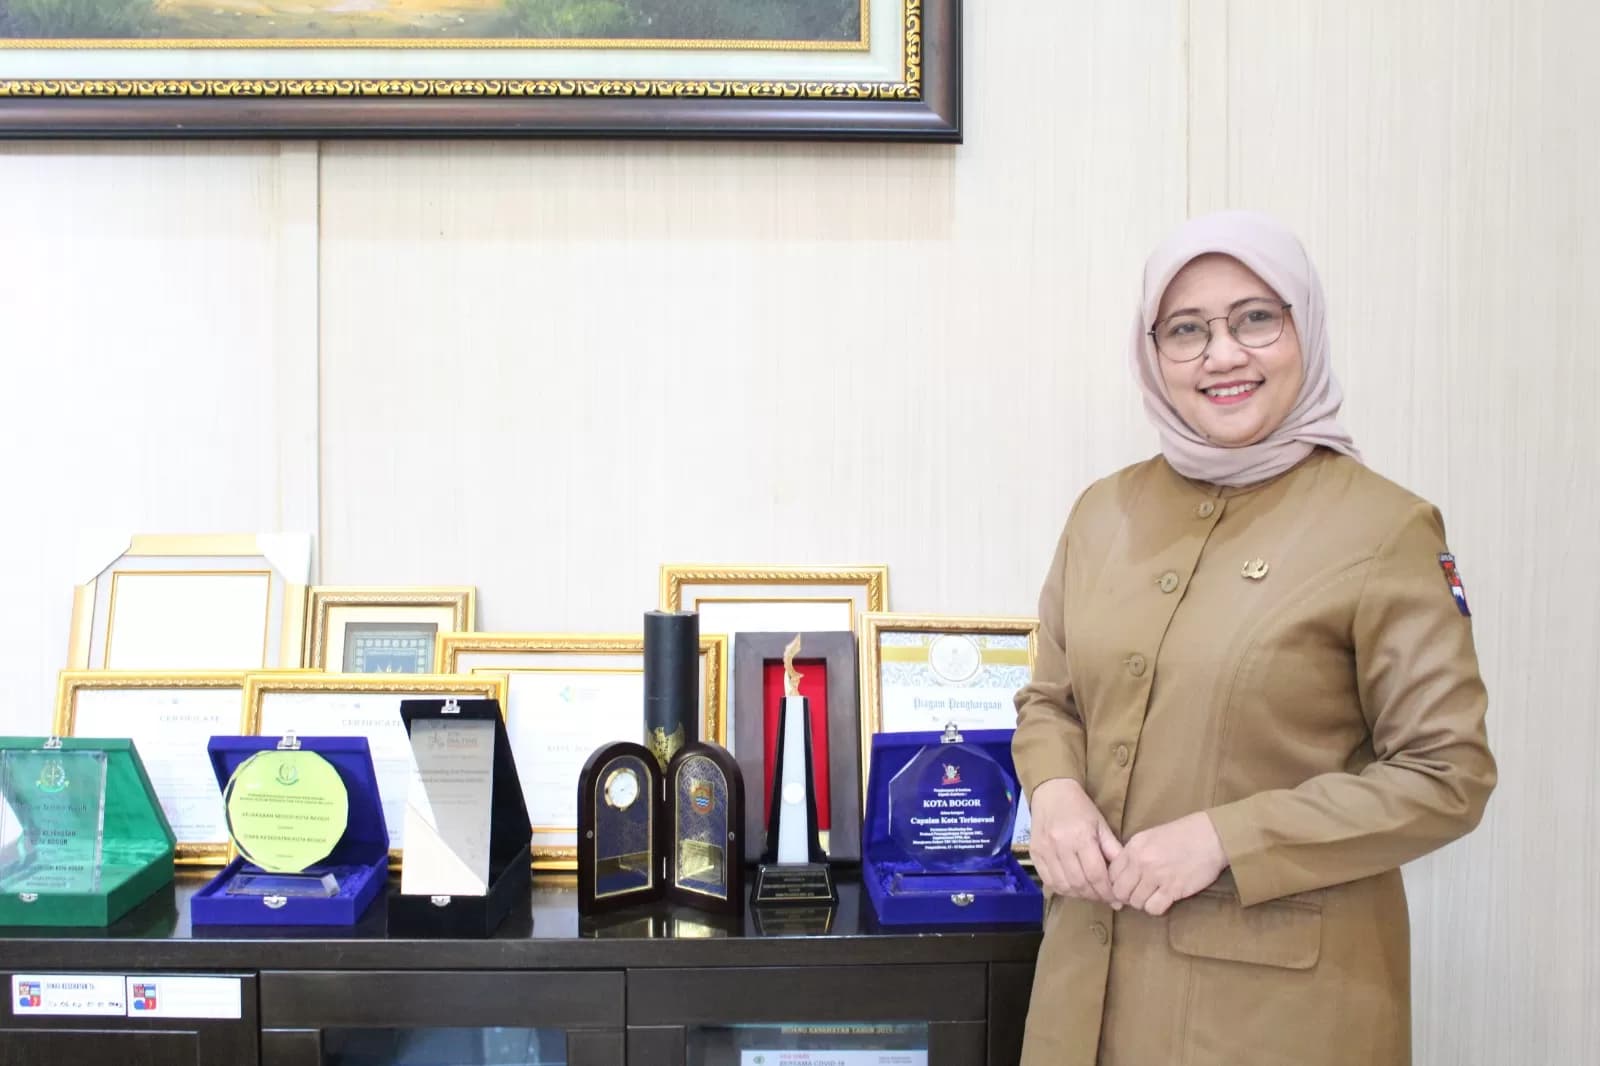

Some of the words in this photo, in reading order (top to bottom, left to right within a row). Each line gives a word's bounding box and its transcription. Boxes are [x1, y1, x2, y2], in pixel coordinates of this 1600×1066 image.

[923, 800, 948, 808] KOTA
[949, 799, 981, 807] BOGOR
[910, 817, 940, 826] Capaian
